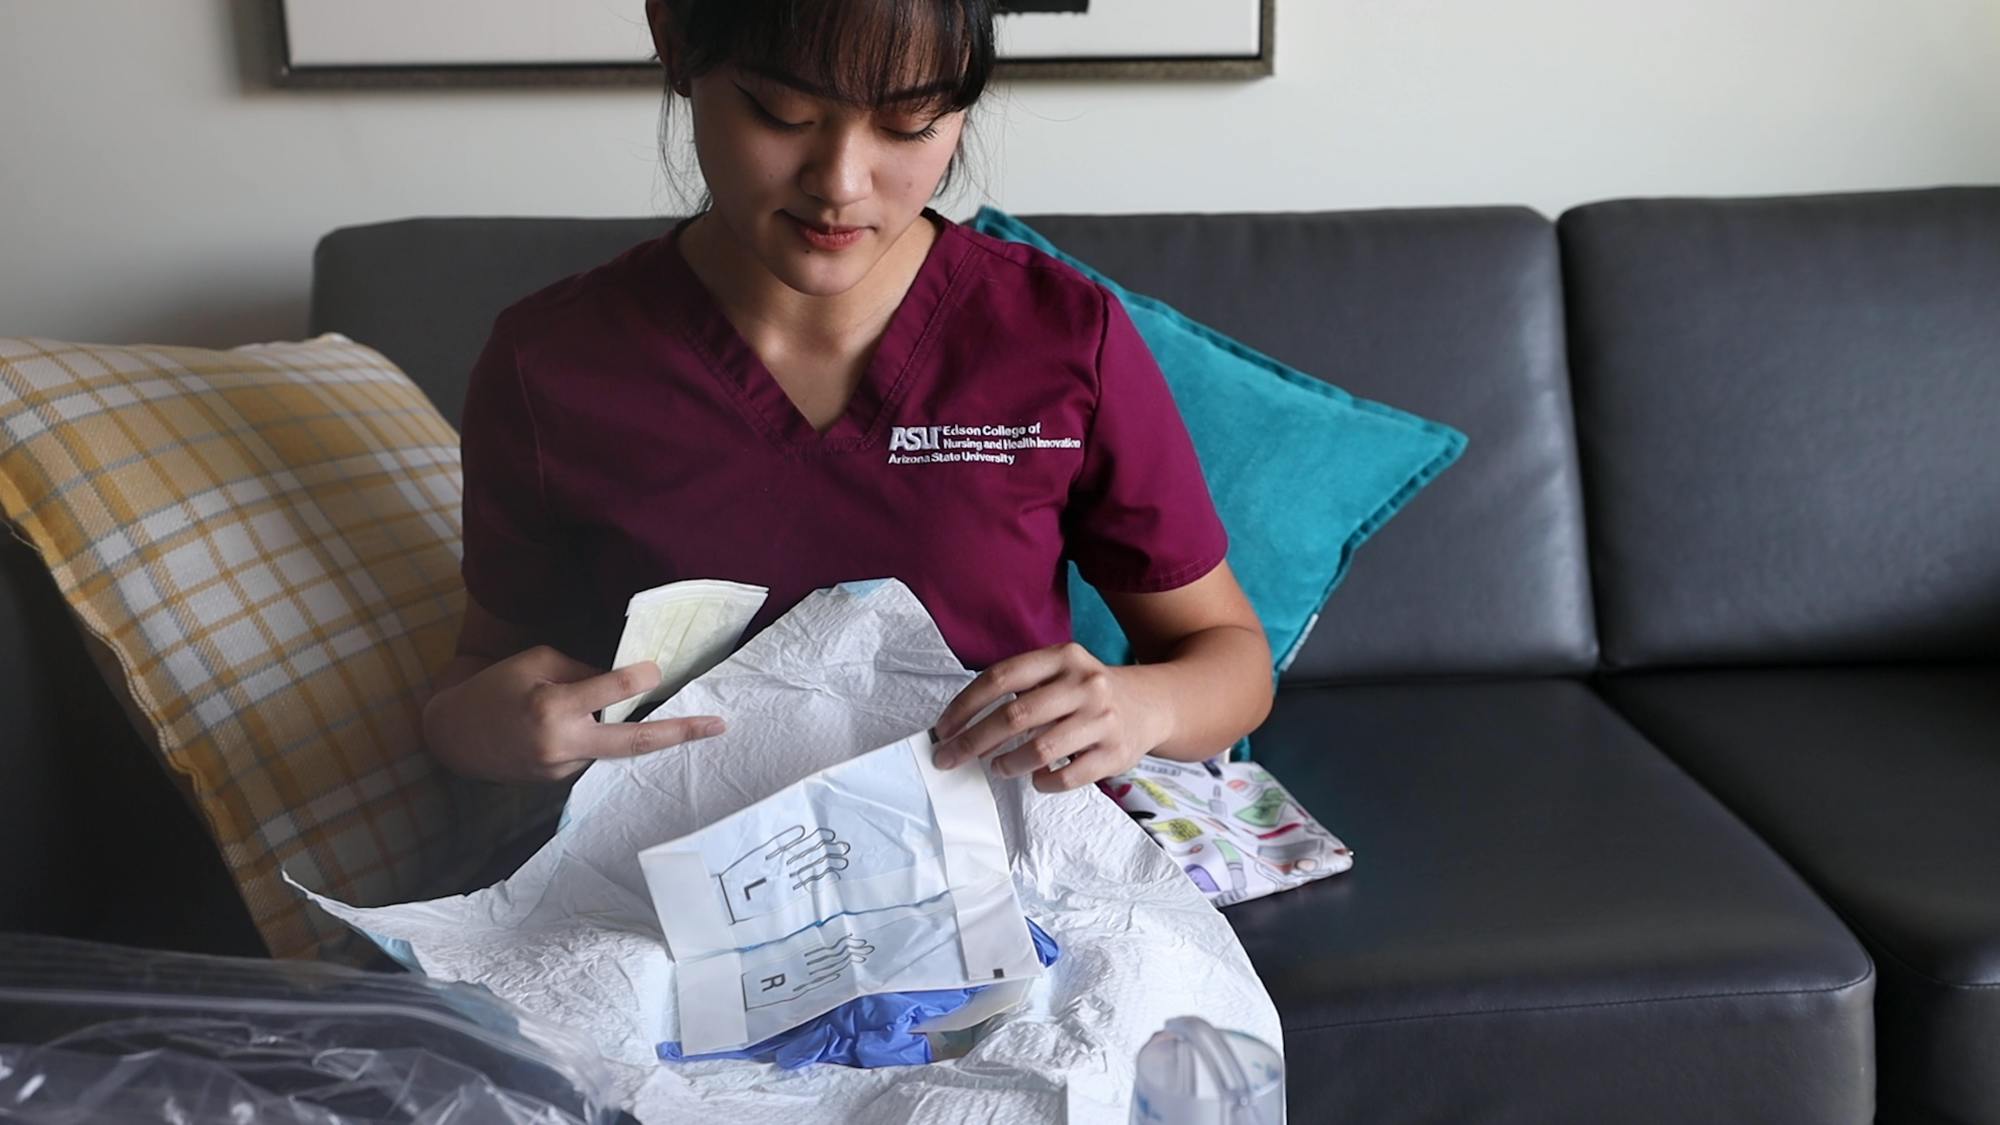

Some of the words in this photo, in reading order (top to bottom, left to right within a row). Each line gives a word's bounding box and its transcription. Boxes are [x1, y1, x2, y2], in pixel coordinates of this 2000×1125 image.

[889, 426, 941, 451] ASU
[943, 424, 981, 436] Edson
[983, 424, 1026, 438] College
[1028, 422, 1041, 434] of
[943, 438, 983, 451] Nursing
[984, 439, 1002, 450] and
[1005, 437, 1036, 450] Health
[1036, 437, 1081, 449] Innovation
[888, 453, 930, 465] Arizona
[931, 452, 960, 463] State
[961, 451, 1015, 466] University
[743, 877, 767, 901] L
[760, 973, 786, 993] R
